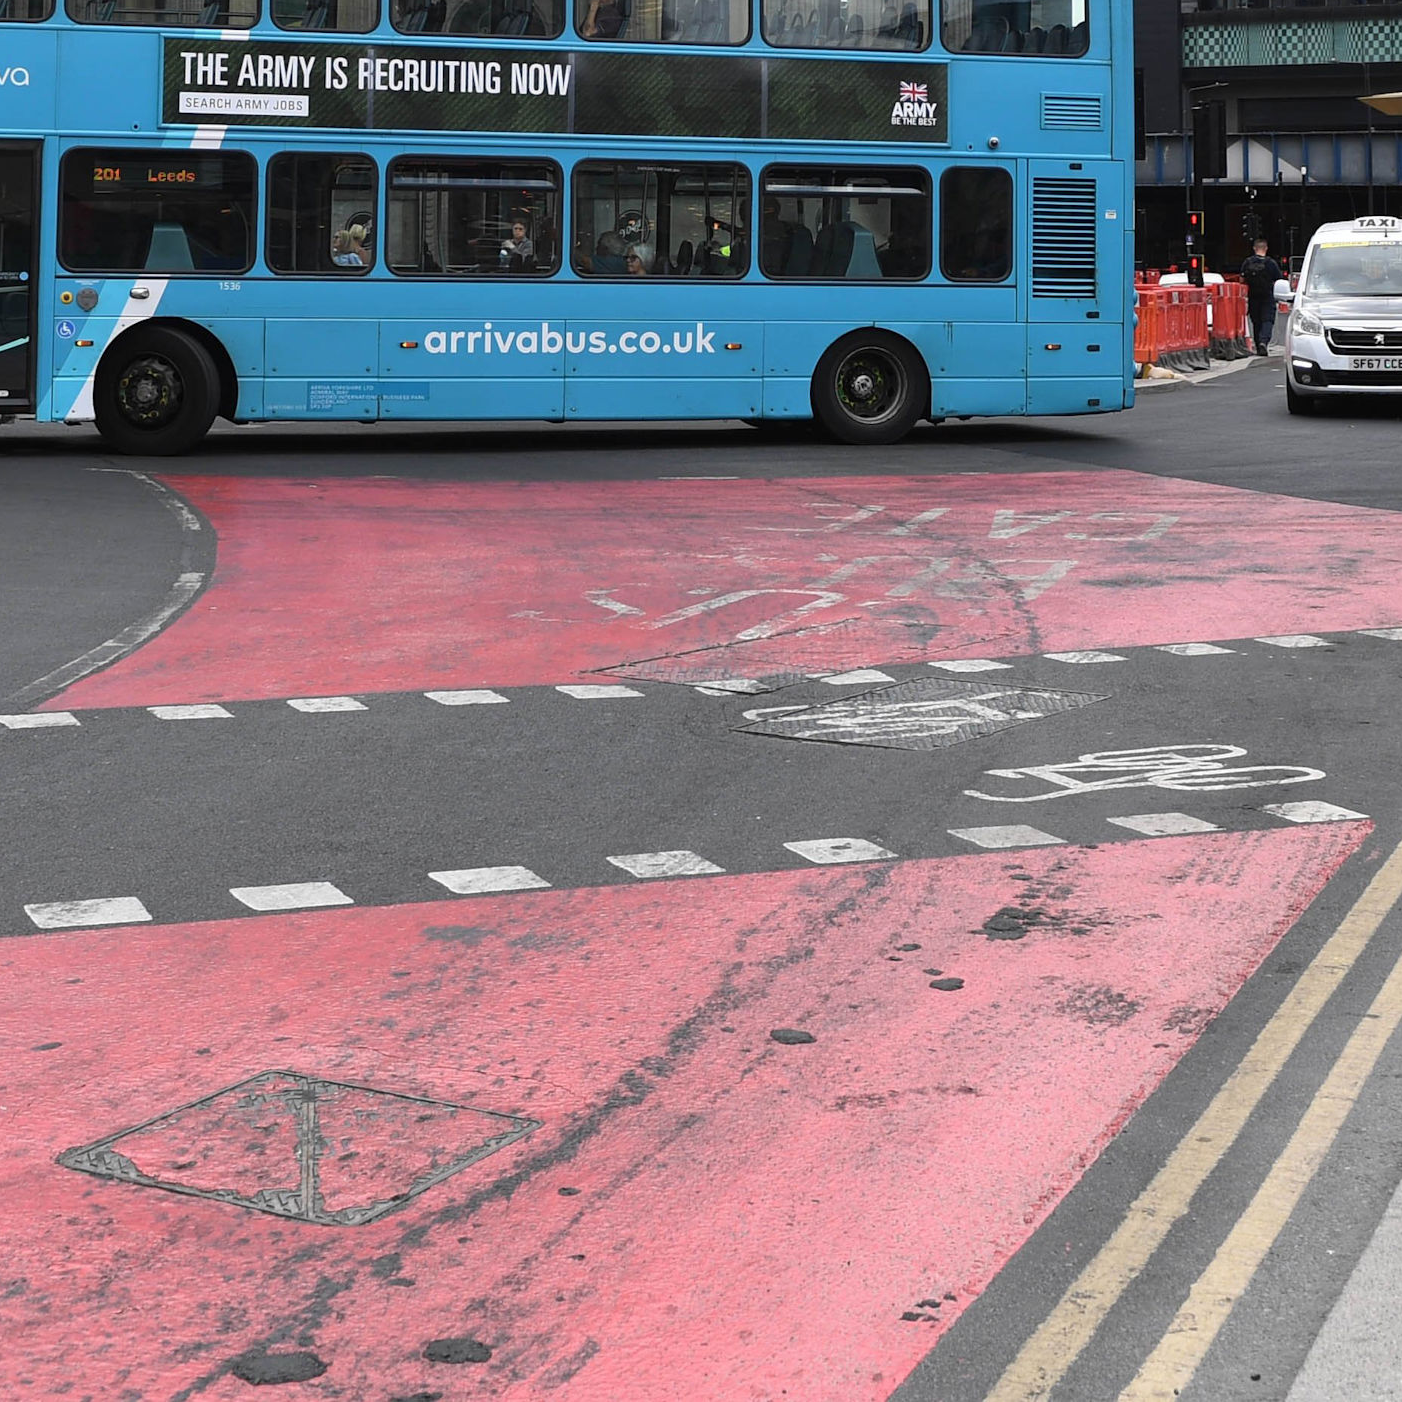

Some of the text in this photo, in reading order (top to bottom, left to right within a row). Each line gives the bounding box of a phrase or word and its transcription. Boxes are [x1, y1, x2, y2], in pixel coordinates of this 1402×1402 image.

[180, 52, 572, 96] THE ARMY IS RECRUITING NOW
[186, 98, 303, 111] SEARCH ARMY JOBS
[892, 102, 937, 118] ARMY
[94, 168, 196, 182] 201 Leeds
[219, 282, 241, 290] 1536
[424, 322, 716, 353] arrivabus.co.uk
[1353, 359, 1380, 368] SF67
